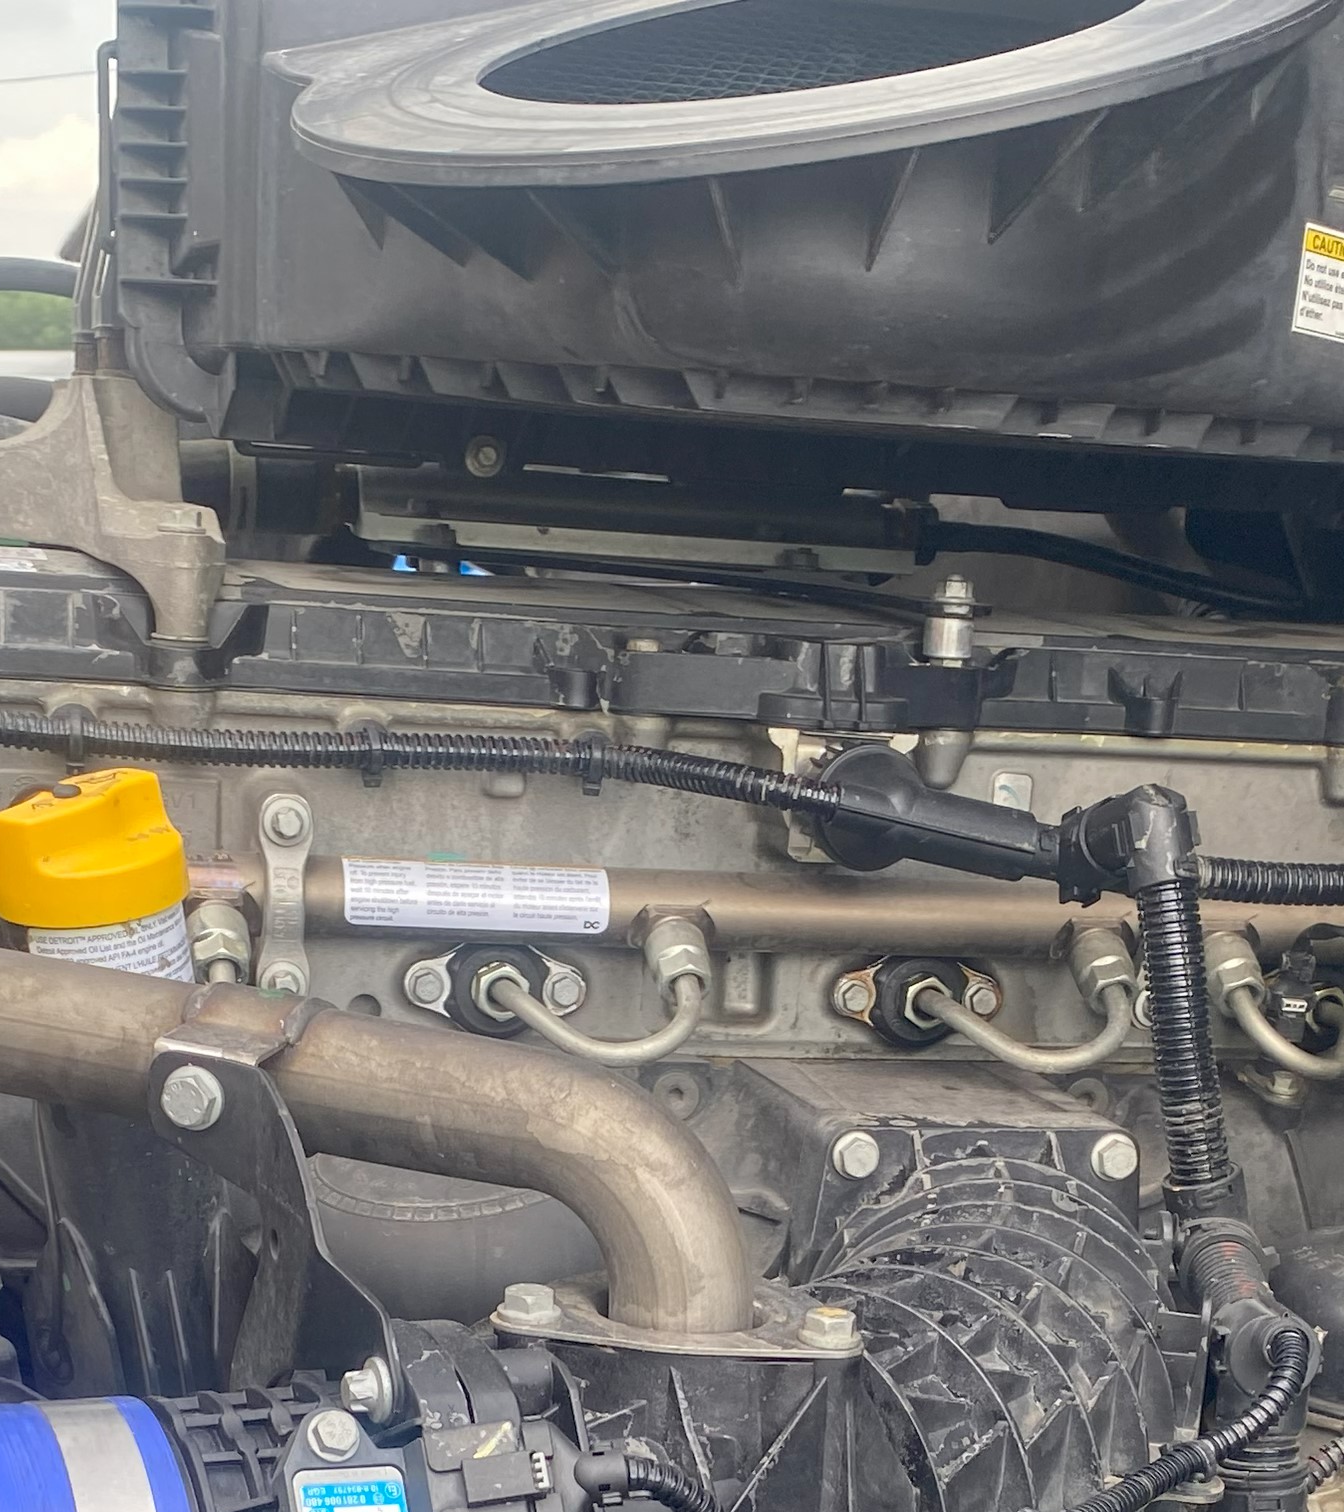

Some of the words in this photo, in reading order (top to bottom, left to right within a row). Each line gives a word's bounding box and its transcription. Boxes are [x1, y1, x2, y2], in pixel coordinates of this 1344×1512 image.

[1306, 259, 1315, 271] Do
[584, 921, 600, 929] DC
[87, 930, 128, 943] APPROVED
